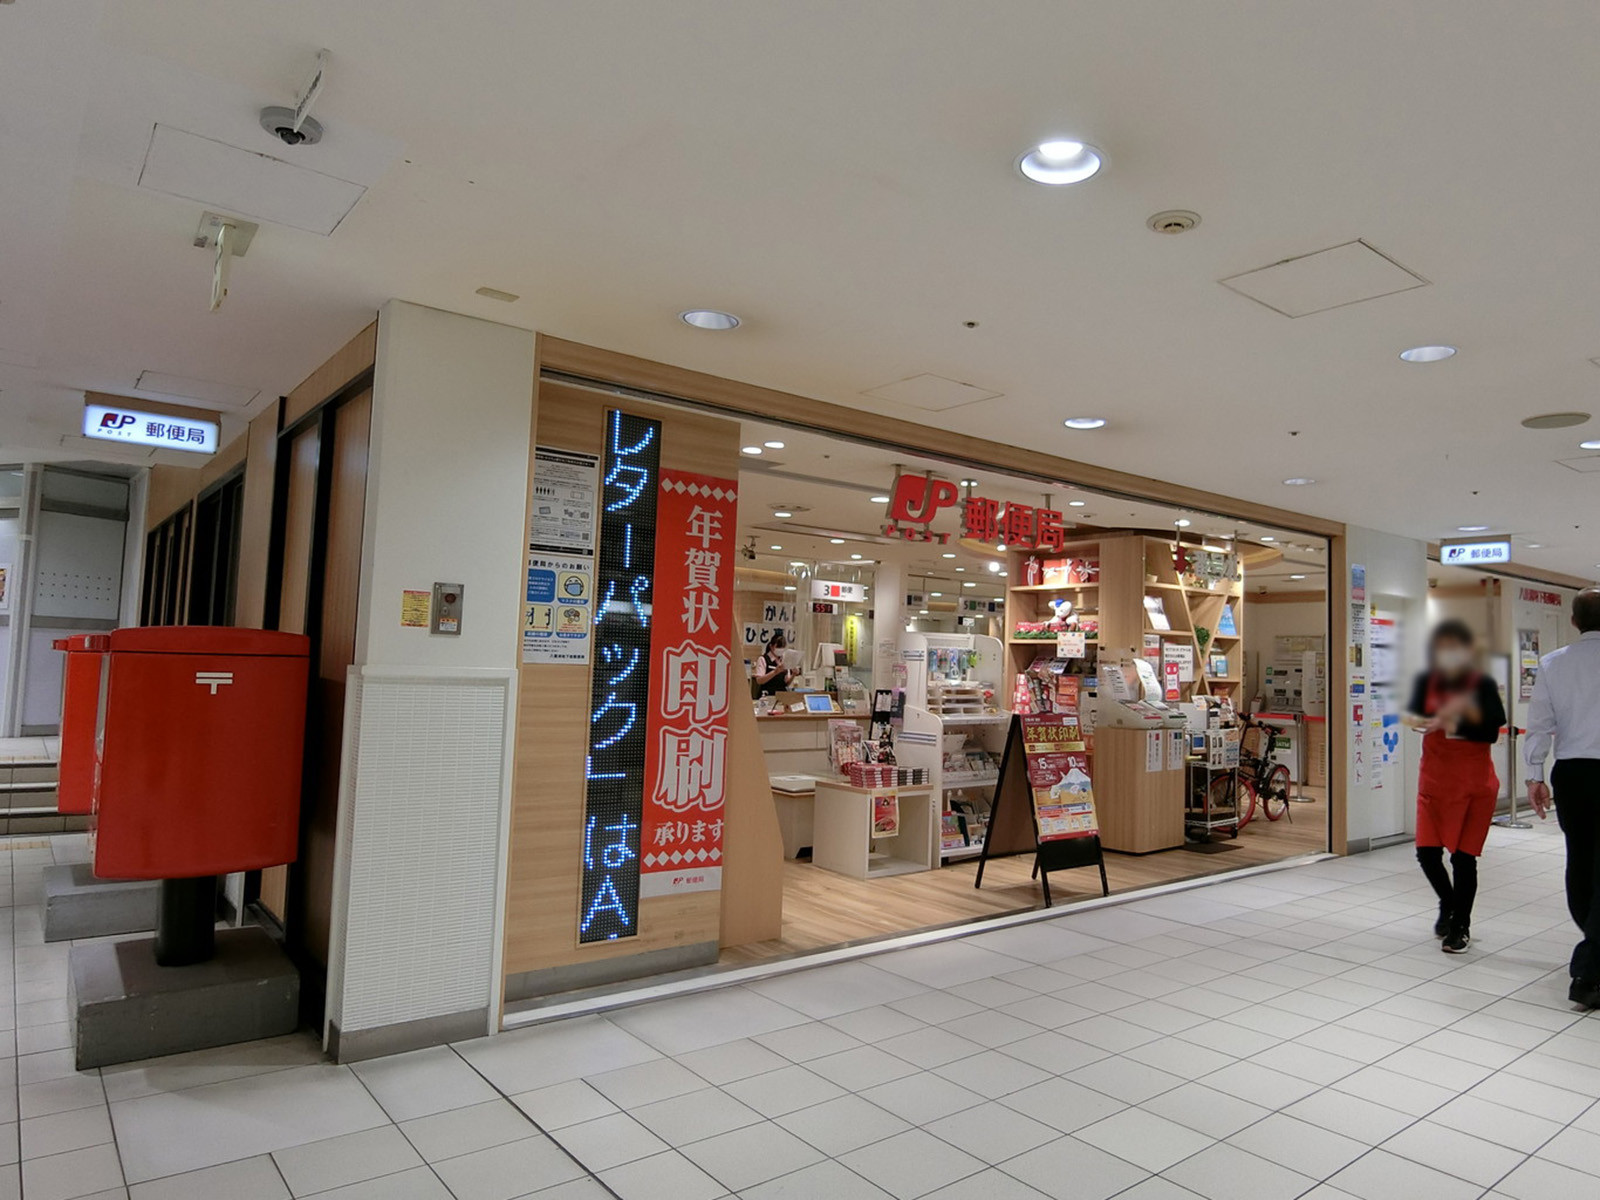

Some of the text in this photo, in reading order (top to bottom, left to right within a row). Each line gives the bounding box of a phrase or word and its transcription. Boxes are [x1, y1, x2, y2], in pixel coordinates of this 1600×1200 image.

[97, 428, 132, 437] POST
[146, 421, 206, 445] 郵便局
[885, 524, 950, 545] POST
[963, 497, 1065, 552] 郵便局
[823, 584, 830, 596] 3
[652, 818, 724, 846] 承ります
